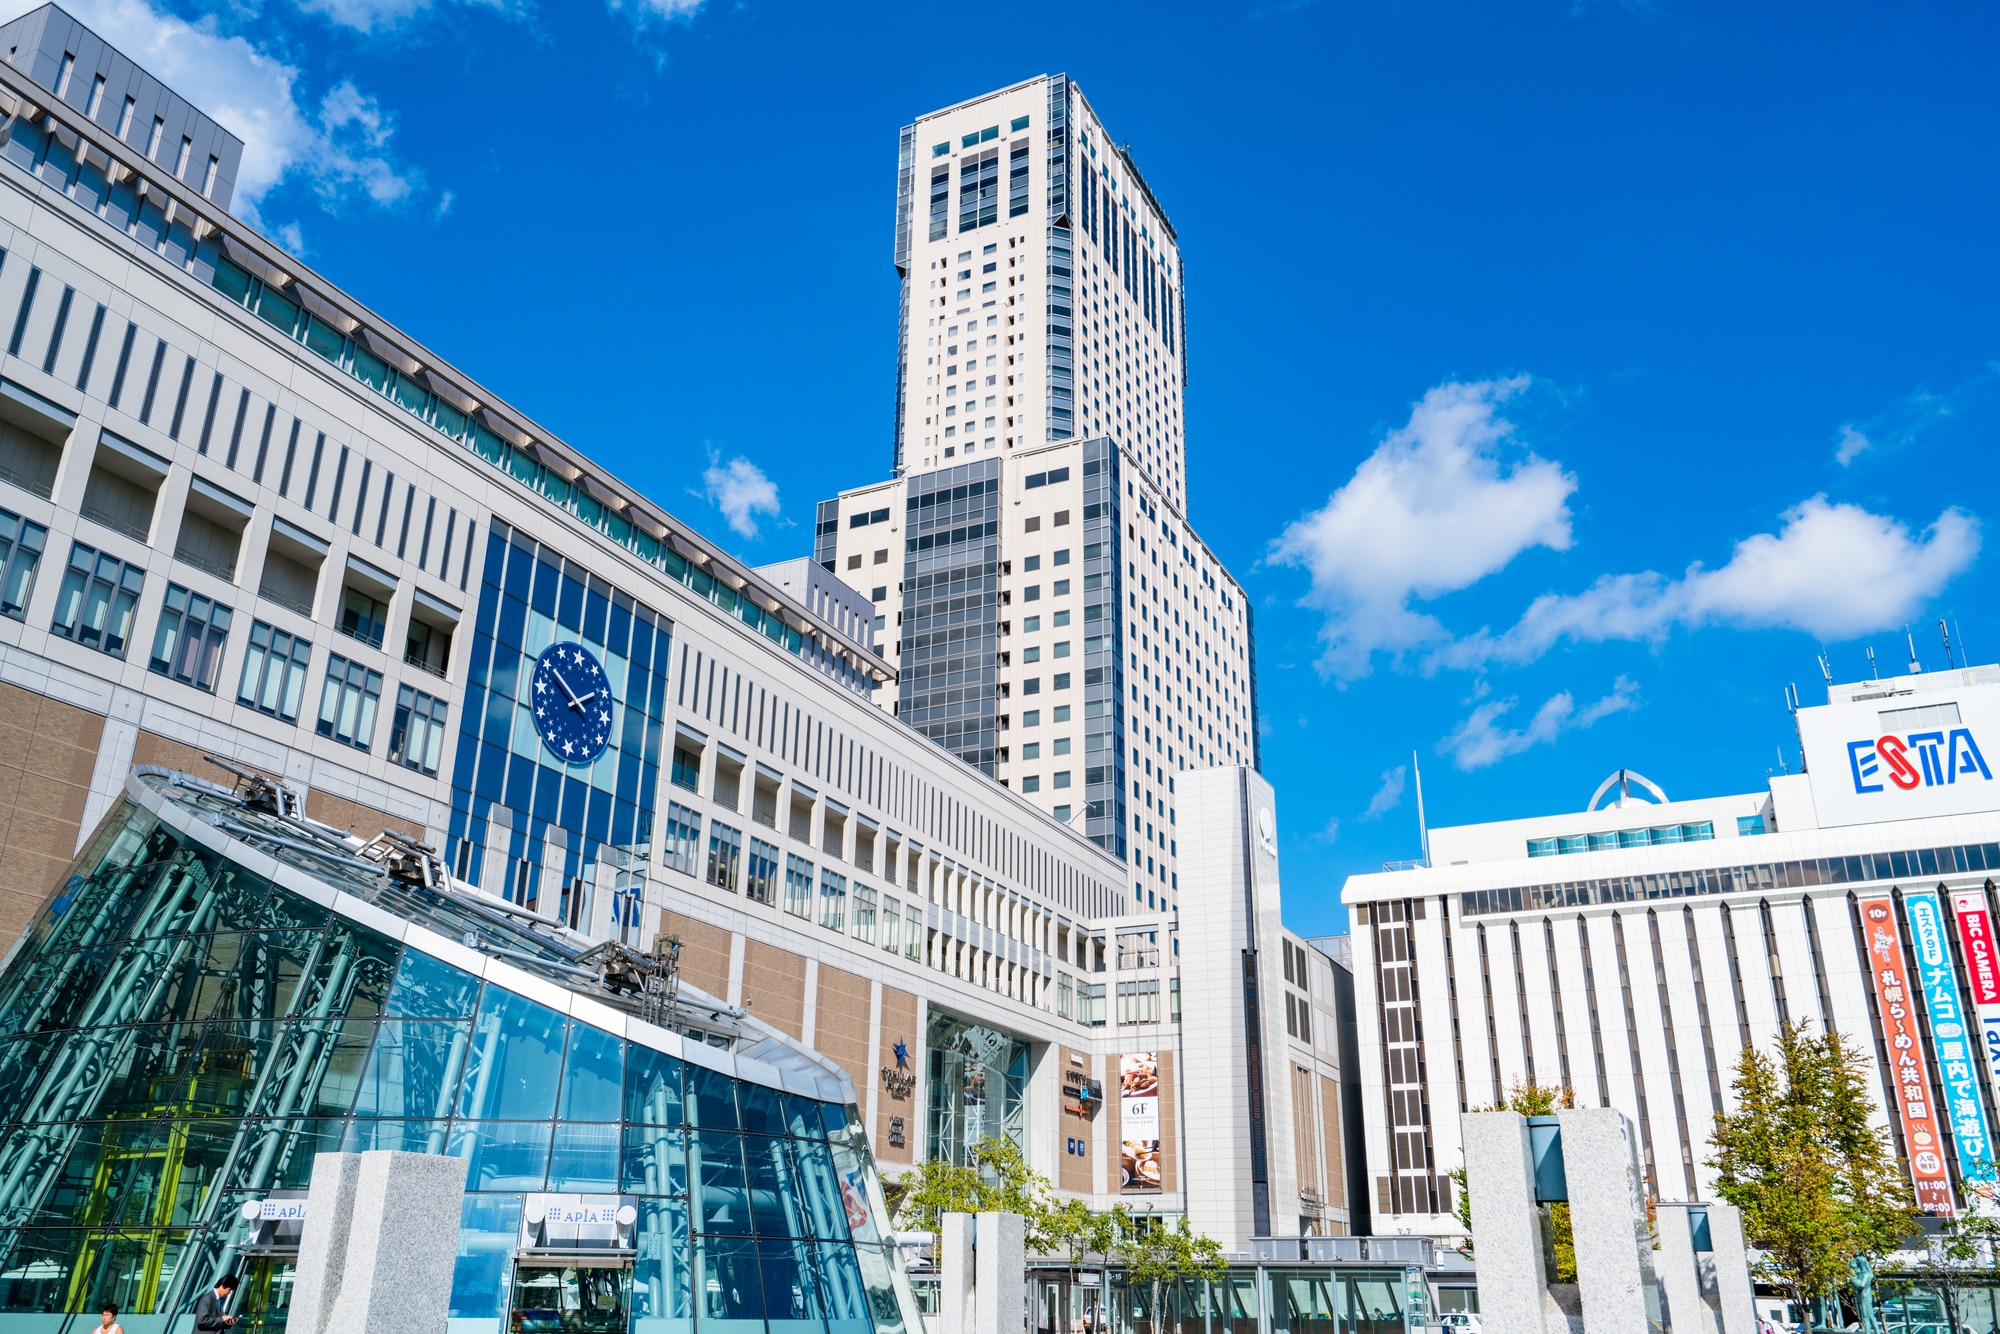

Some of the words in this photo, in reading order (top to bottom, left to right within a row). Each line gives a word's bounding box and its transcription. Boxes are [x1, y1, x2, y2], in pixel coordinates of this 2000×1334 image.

[1847, 728, 1993, 794] ESTA
[1868, 909, 1888, 918] 10F
[1919, 908, 1937, 960] エスタ9F
[1966, 914, 1984, 938] BIC
[1971, 940, 1997, 1001] CAMERA
[1927, 968, 1955, 1018] ナムコ
[1132, 1102, 1148, 1115] 6F
[1918, 1181, 1946, 1190] 11:00
[278, 1202, 307, 1217] API
